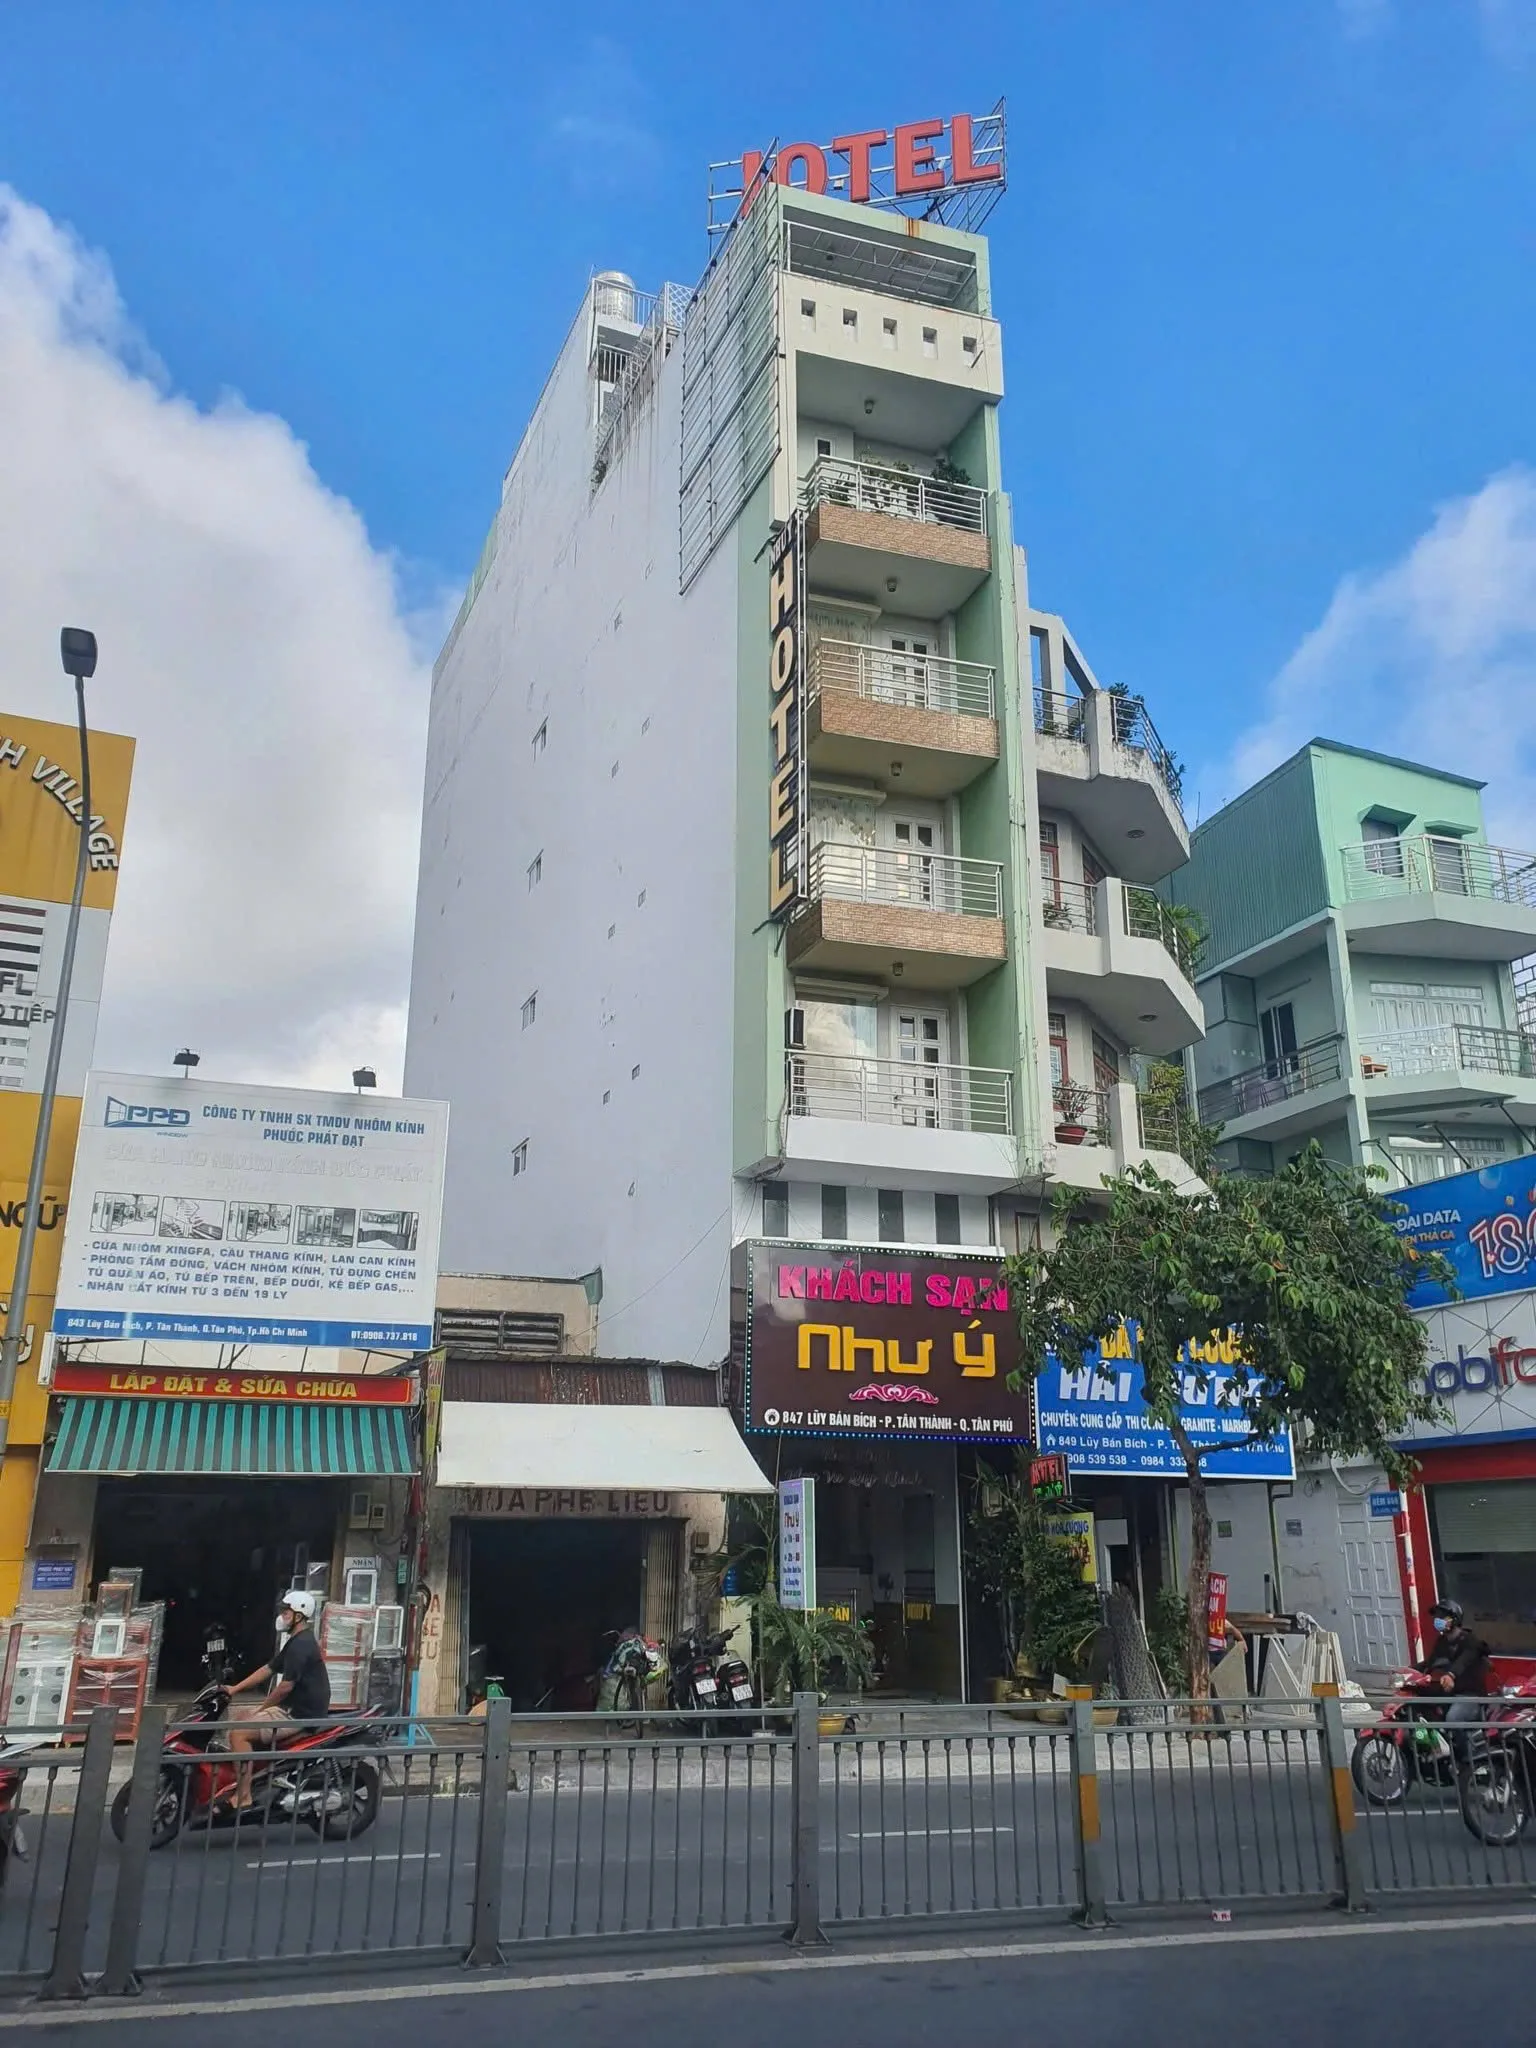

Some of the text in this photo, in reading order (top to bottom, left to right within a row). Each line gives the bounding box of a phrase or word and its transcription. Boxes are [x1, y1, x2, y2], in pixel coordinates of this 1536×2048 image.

[770, 552, 795, 915] HOTEL
[31, 755, 119, 870] VILLAGE
[203, 1104, 425, 1134] CÔNG TY TNHH SX TMDV NHÔM KÍNH
[307, 1130, 339, 1145] PHÁT
[342, 1134, 365, 1148] ĐẠT
[1423, 1209, 1461, 1226] DATA
[1440, 1230, 1455, 1240] GA
[1469, 1208, 1536, 1278] 18
[123, 1242, 161, 1253] NHÔM
[166, 1245, 215, 1257] XINGFA,
[249, 1250, 289, 1260] THANG
[294, 1251, 327, 1264] KÍNH,
[331, 1254, 355, 1264] LAN
[359, 1256, 383, 1265] CAN
[387, 1256, 416, 1267] KÍNH
[90, 1253, 135, 1265] PHÒNG
[214, 1260, 246, 1271] VÁCH
[250, 1262, 287, 1273] NHÔM
[291, 1264, 325, 1276] KÍNH,
[385, 1269, 416, 1280] CHÉN
[87, 1281, 124, 1293] NHẬN
[156, 1284, 187, 1294] KÍNH
[212, 1287, 219, 1296] 3
[224, 1286, 249, 1297] ĐẾN
[273, 1291, 288, 1299] LY
[195, 1271, 218, 1283] BẾP
[264, 1275, 287, 1286] BẾP
[348, 1279, 371, 1291] BẾP
[778, 1260, 1009, 1316] KHÁCH SẠN
[288, 1328, 308, 1338] Minh
[110, 1370, 357, 1397] LẮP ĐẶT & SỬA CHỮA
[782, 1410, 803, 1424] 847
[807, 1409, 827, 1425] LŨY
[829, 1410, 851, 1427] BÁN
[853, 1411, 877, 1428] BÍCH
[919, 1414, 952, 1430] THÀNH
[993, 1417, 1013, 1432] PHÚ
[1041, 1410, 1078, 1427] CHUYÊN:
[1080, 1413, 1104, 1428] CUNG
[1106, 1411, 1122, 1429] CẤP
[1125, 1415, 1139, 1430] THI
[1181, 1417, 1216, 1433] GRANITE
[1058, 1435, 1077, 1446] 849
[1080, 1436, 1099, 1449] Lũy
[1102, 1437, 1121, 1448] Bán
[1124, 1438, 1147, 1449] Bích
[1158, 1439, 1168, 1450] P.
[1088, 1454, 1106, 1465] 539
[1109, 1454, 1127, 1465] 538
[1140, 1456, 1164, 1466] 0984
